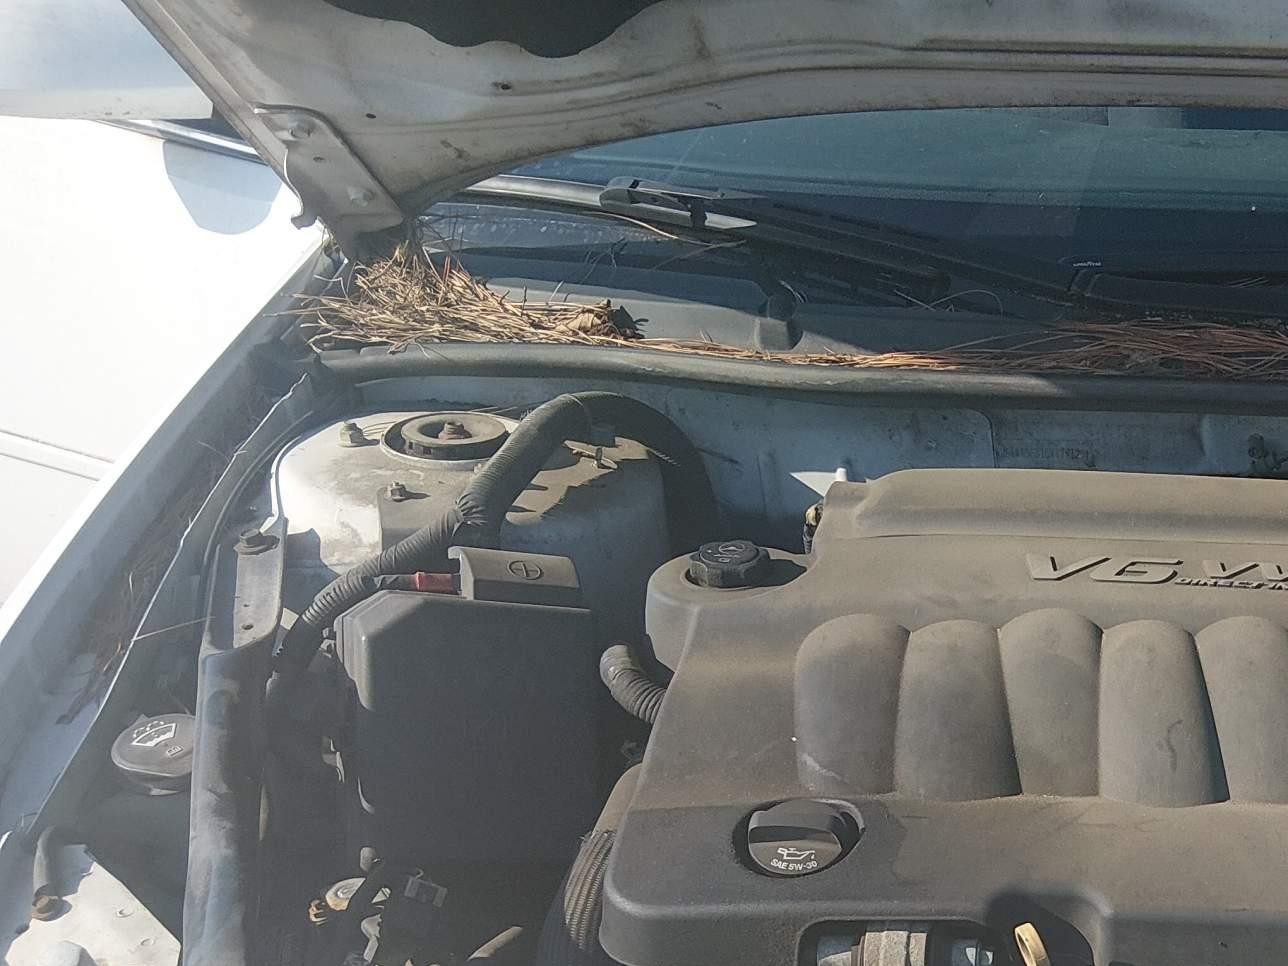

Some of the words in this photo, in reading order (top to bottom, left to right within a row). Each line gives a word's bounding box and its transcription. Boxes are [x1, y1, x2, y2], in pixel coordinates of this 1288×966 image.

[1027, 553, 1184, 585] V6
[1175, 577, 1264, 590] DIRECT
[770, 858, 788, 870] SAE
[788, 860, 818, 871] 5W-30
